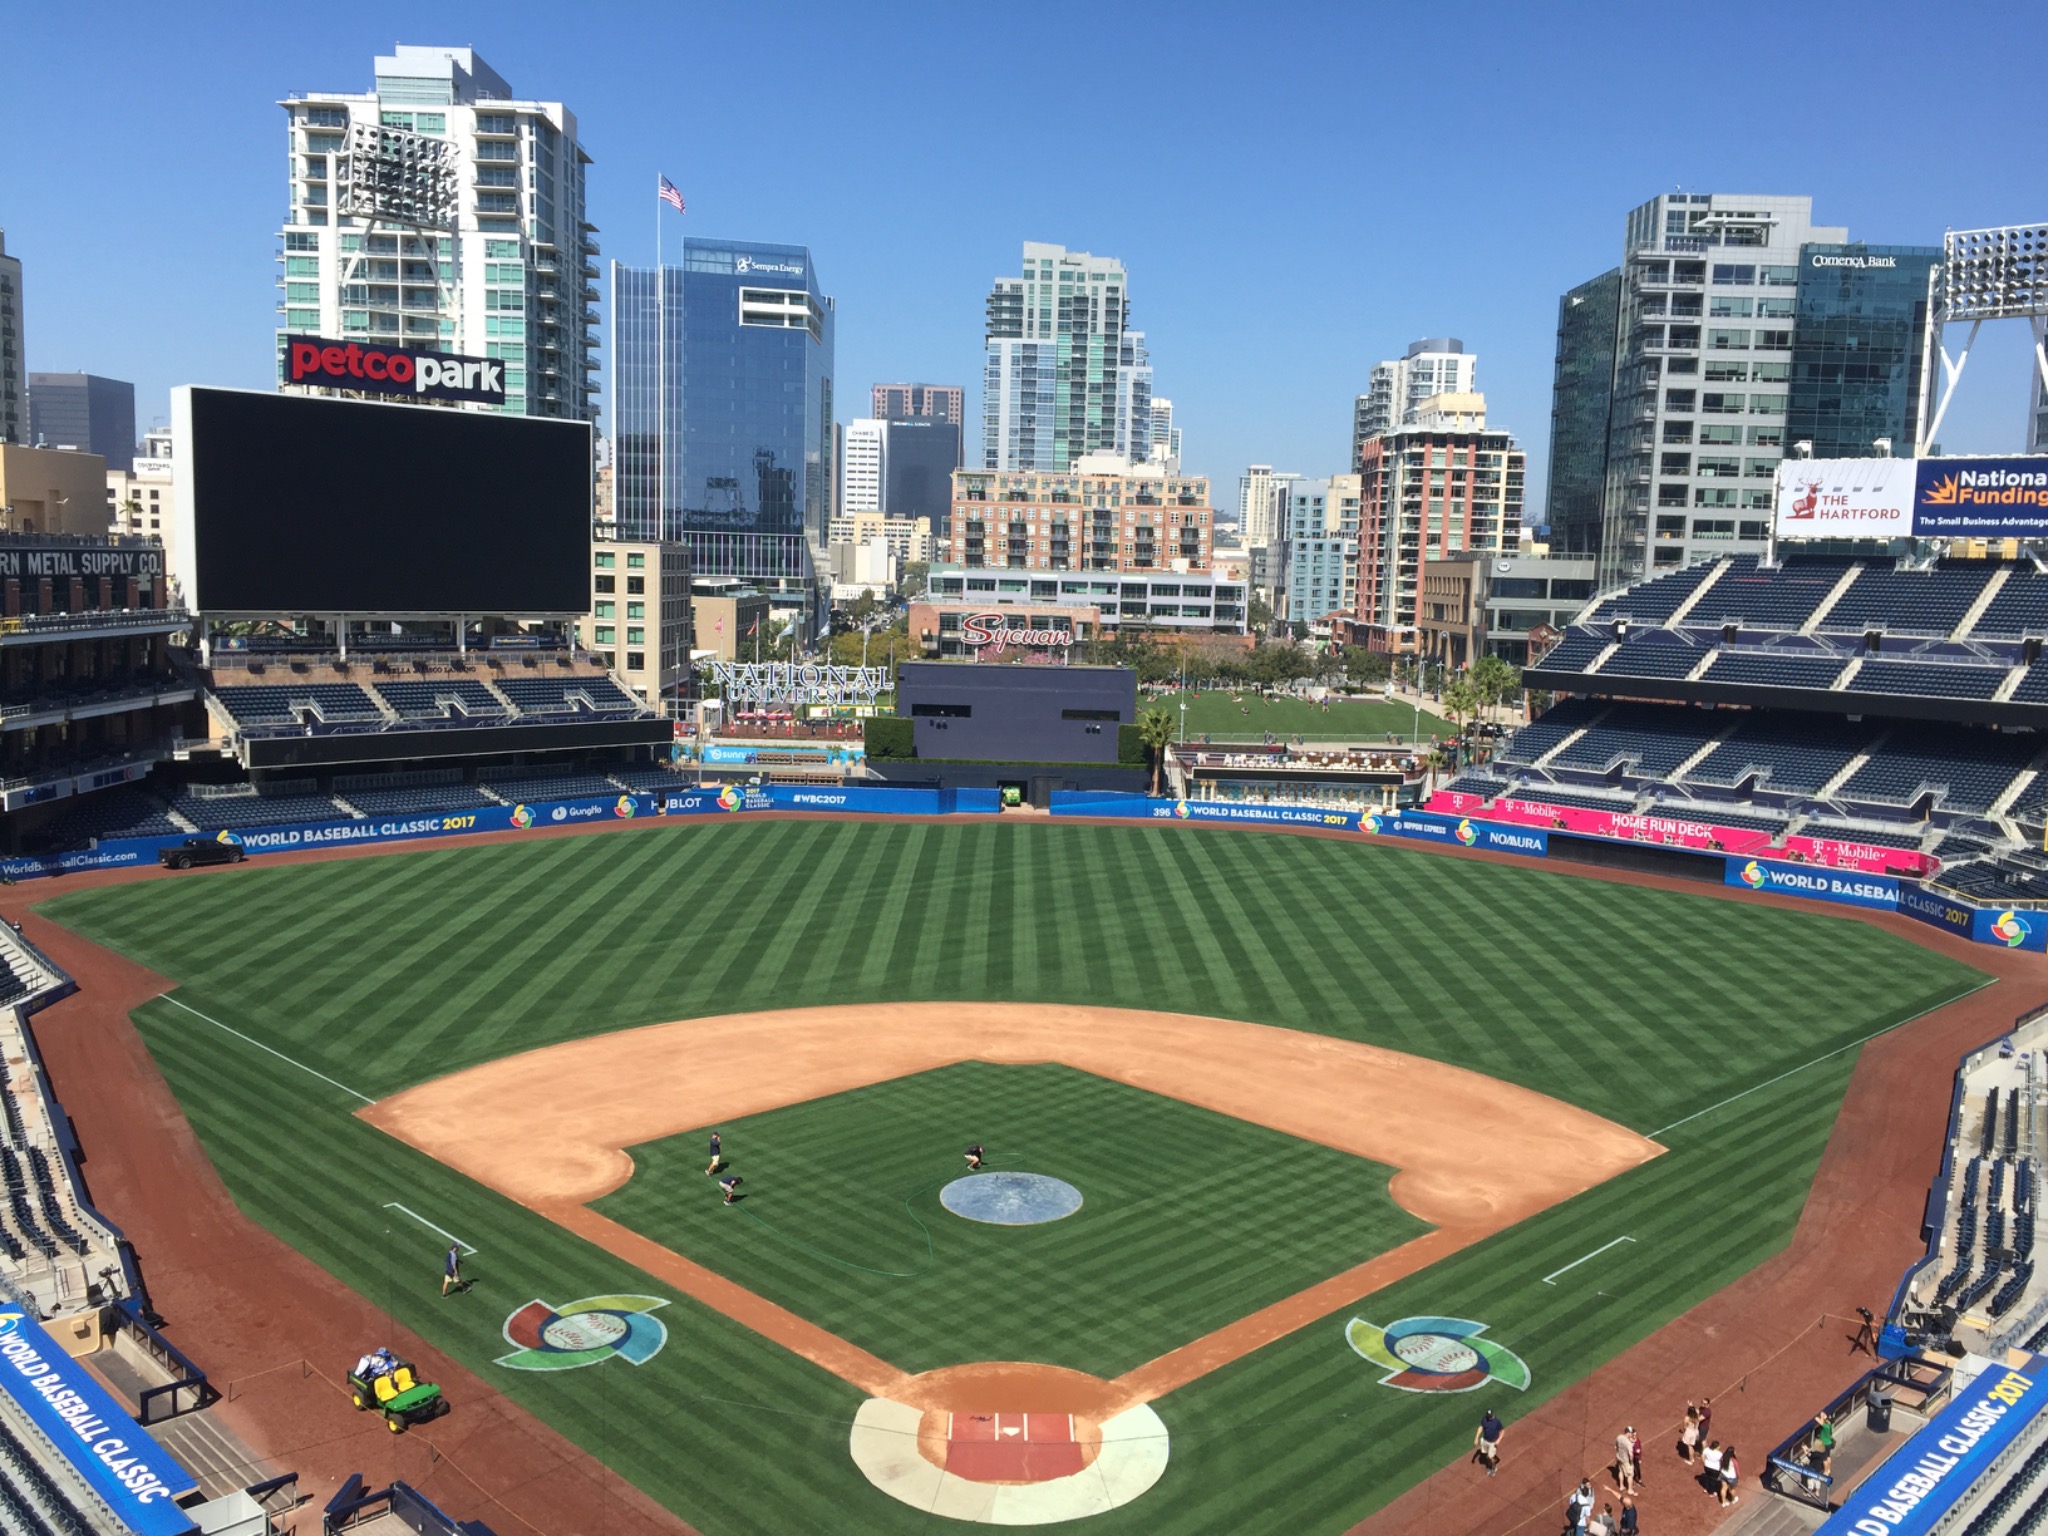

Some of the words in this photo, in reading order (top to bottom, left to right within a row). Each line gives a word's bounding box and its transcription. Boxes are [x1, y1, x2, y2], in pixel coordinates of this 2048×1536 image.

[752, 262, 778, 272] Sempra
[780, 264, 803, 275] Energy
[1868, 256, 1896, 267] Bank
[1822, 495, 1848, 506] THE
[1820, 509, 1900, 519] HARTFORD
[1920, 517, 1935, 525] The
[1937, 517, 1960, 526] Small
[1963, 517, 2000, 526] Business
[28, 552, 78, 575] METAL
[82, 553, 133, 575] SUPPLY
[139, 554, 161, 574] CO.
[961, 613, 1074, 653] Sycuan
[711, 662, 894, 689] NATIONAL
[726, 685, 880, 704] UNIVERSITY
[793, 794, 846, 804] #WBC2017
[569, 806, 602, 816] GungHo
[1153, 807, 1171, 817] 396
[1193, 805, 1228, 817] WORLD
[1230, 808, 1280, 819] BASEBALL
[1281, 811, 1322, 823] CLASSIC
[1323, 813, 1348, 825] 2017
[243, 831, 301, 848] WORLD
[303, 824, 378, 843] BASEBALL
[380, 818, 440, 836] CLASSIC
[442, 815, 477, 831] 2017
[1611, 813, 1647, 829] HOME
[1649, 819, 1676, 833] RUN
[1677, 823, 1713, 839] DECK
[1489, 831, 1543, 850] NOMURA
[1770, 871, 1828, 892] WORLD
[1831, 881, 1905, 905] BASEBALL
[1907, 894, 1945, 918] CLASSIC
[1945, 909, 1969, 926] 2017
[0, 1331, 50, 1377] WORLD
[30, 1372, 110, 1443] BASEBALL
[92, 1438, 170, 1504] CLASSIC
[1868, 1452, 1960, 1525] BASEBALL
[1938, 1399, 2008, 1455] CLASSIC
[1987, 1371, 2034, 1407] 2017
